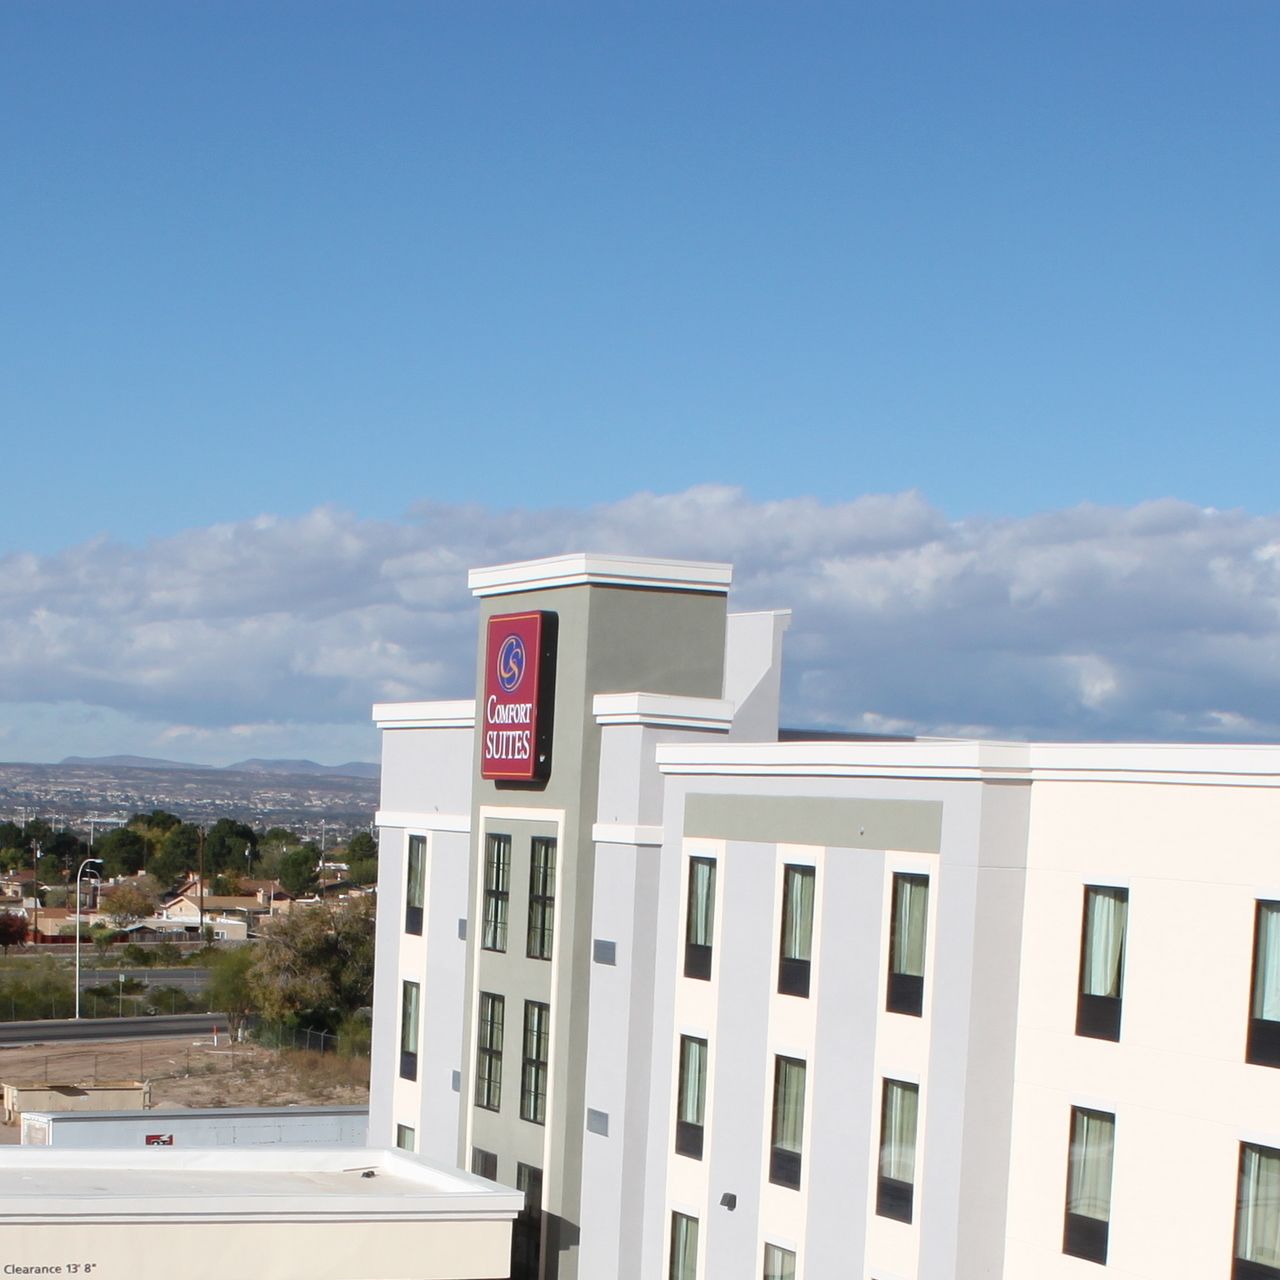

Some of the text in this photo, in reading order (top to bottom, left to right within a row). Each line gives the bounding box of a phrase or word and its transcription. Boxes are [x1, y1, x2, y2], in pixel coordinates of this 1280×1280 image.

[485, 730, 531, 760] SUITES
[3, 1264, 62, 1275] Clearance
[66, 1263, 81, 1274] 13'
